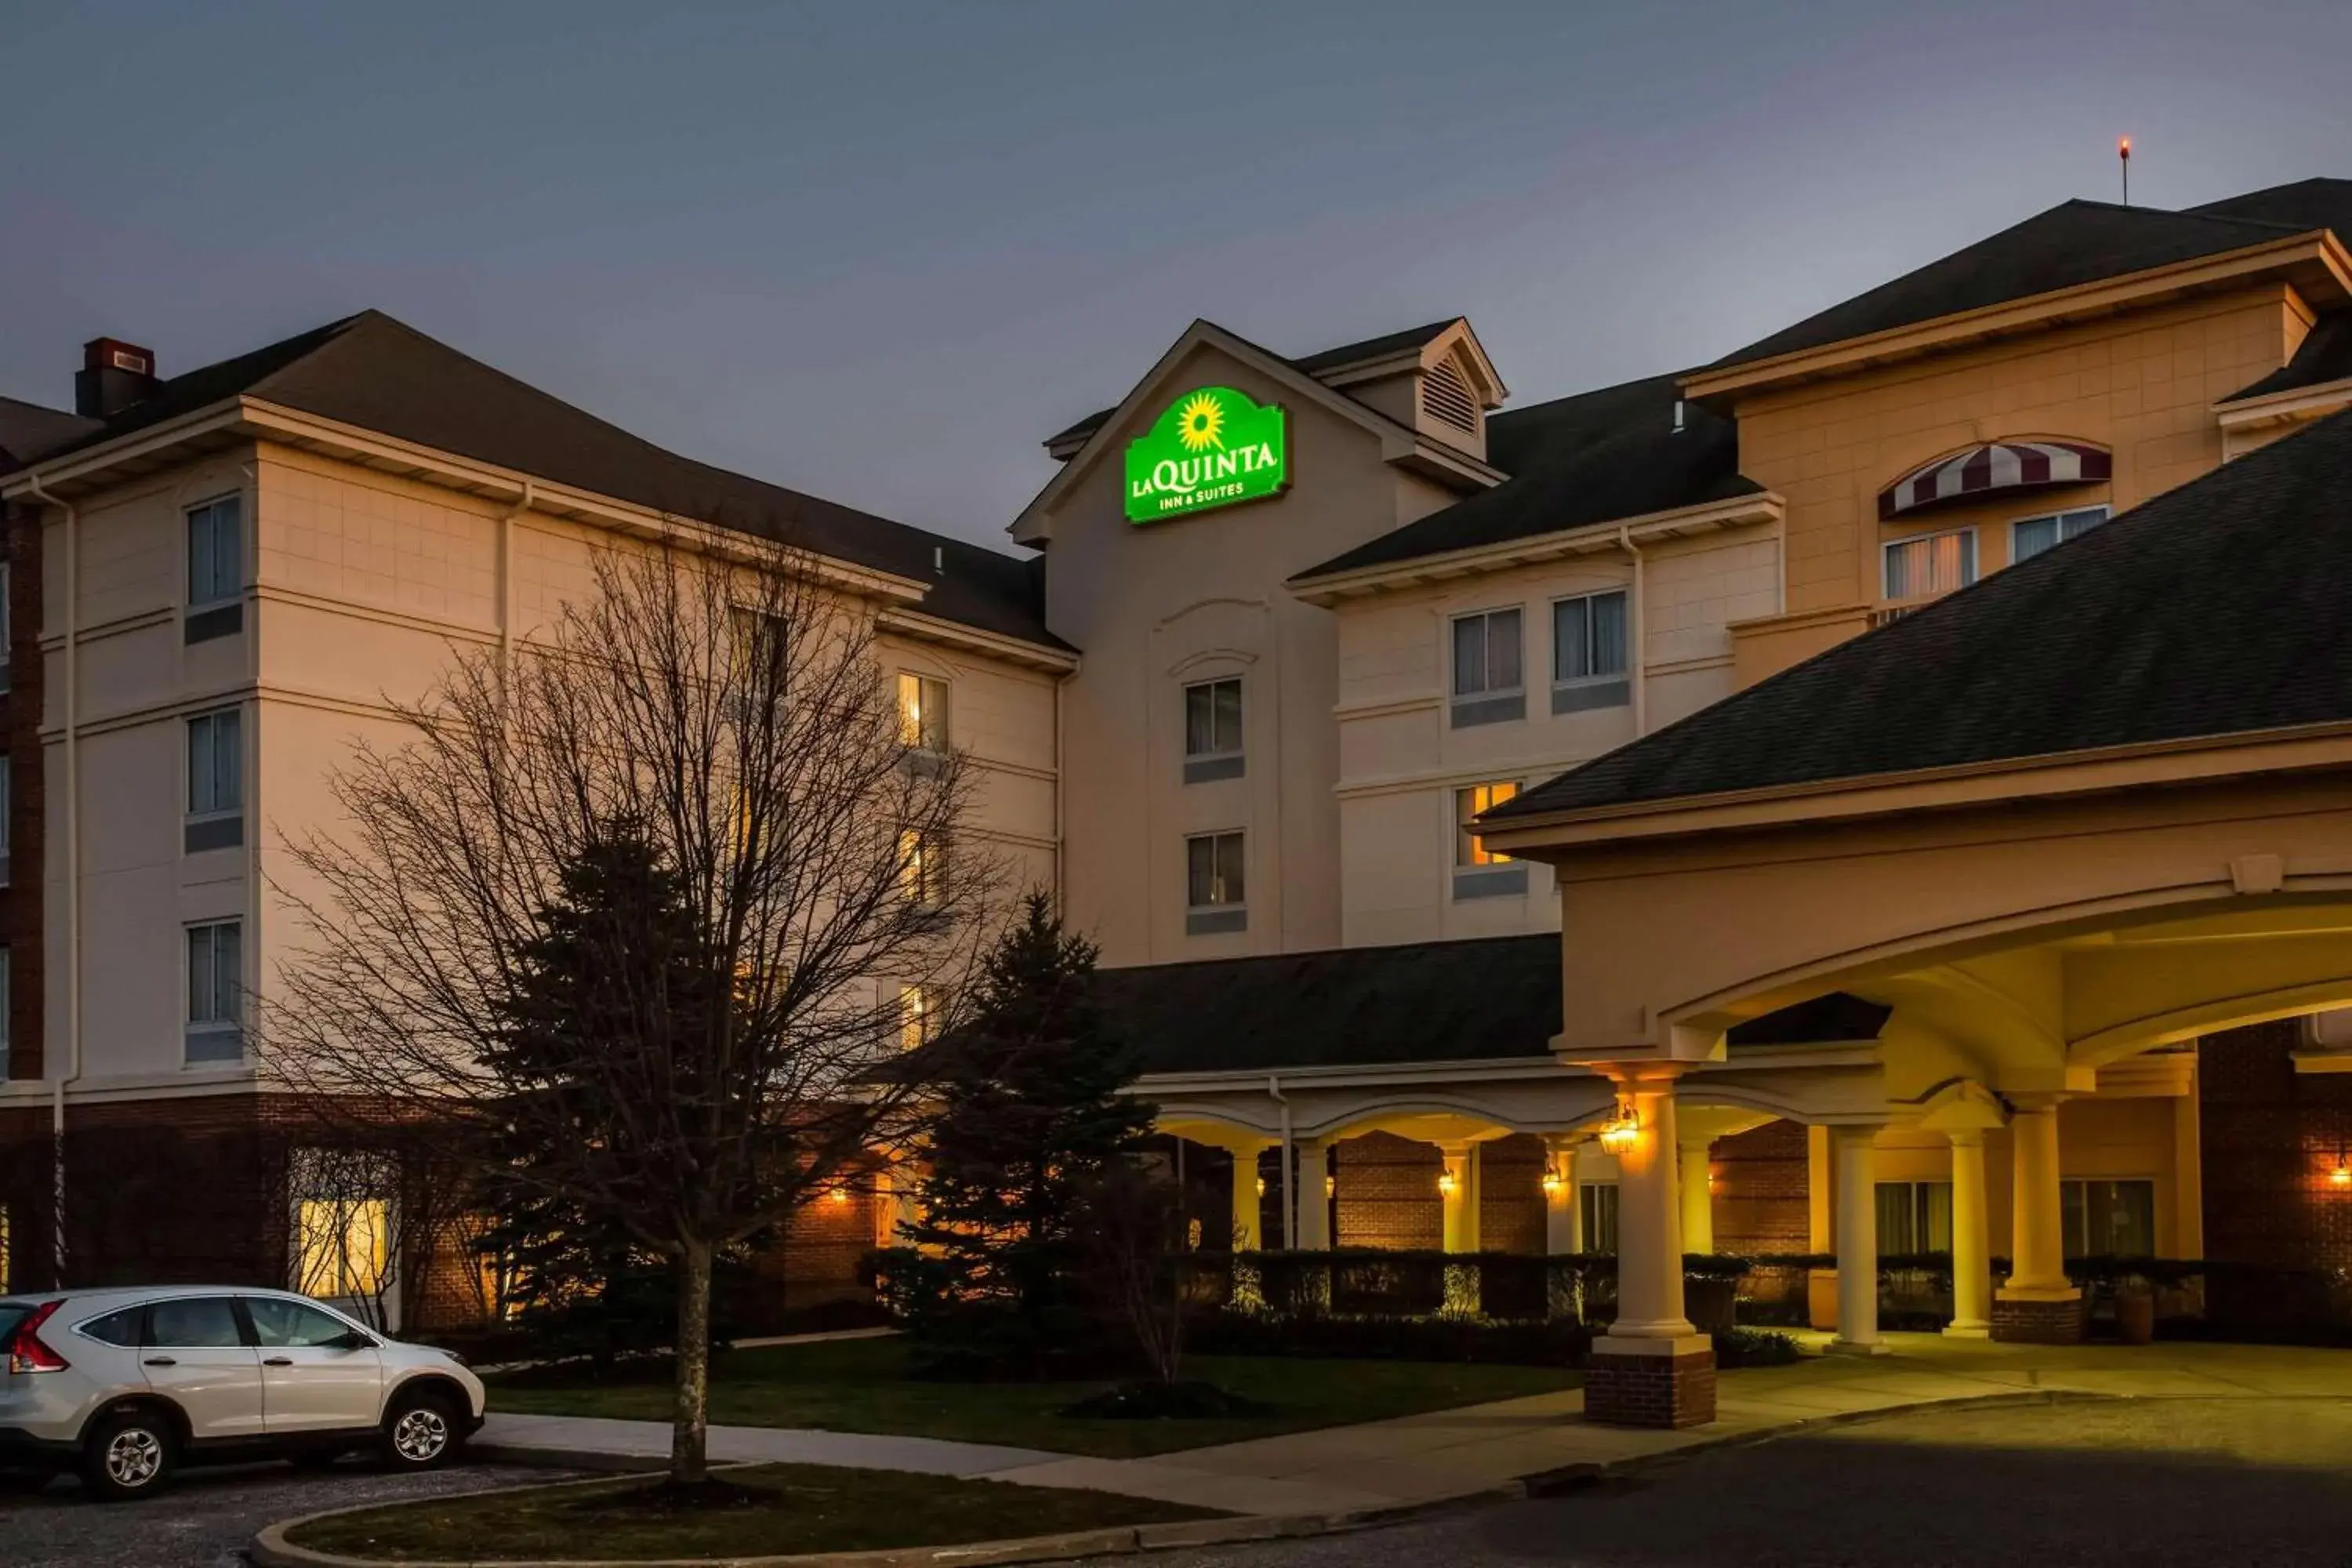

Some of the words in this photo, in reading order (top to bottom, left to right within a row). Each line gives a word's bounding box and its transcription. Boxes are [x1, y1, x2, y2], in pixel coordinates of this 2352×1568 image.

[1133, 479, 1153, 497] LA
[1154, 443, 1277, 492] QUINTA
[1160, 495, 1182, 510] INN
[1185, 495, 1192, 505] &
[1196, 482, 1243, 503] SUITES
